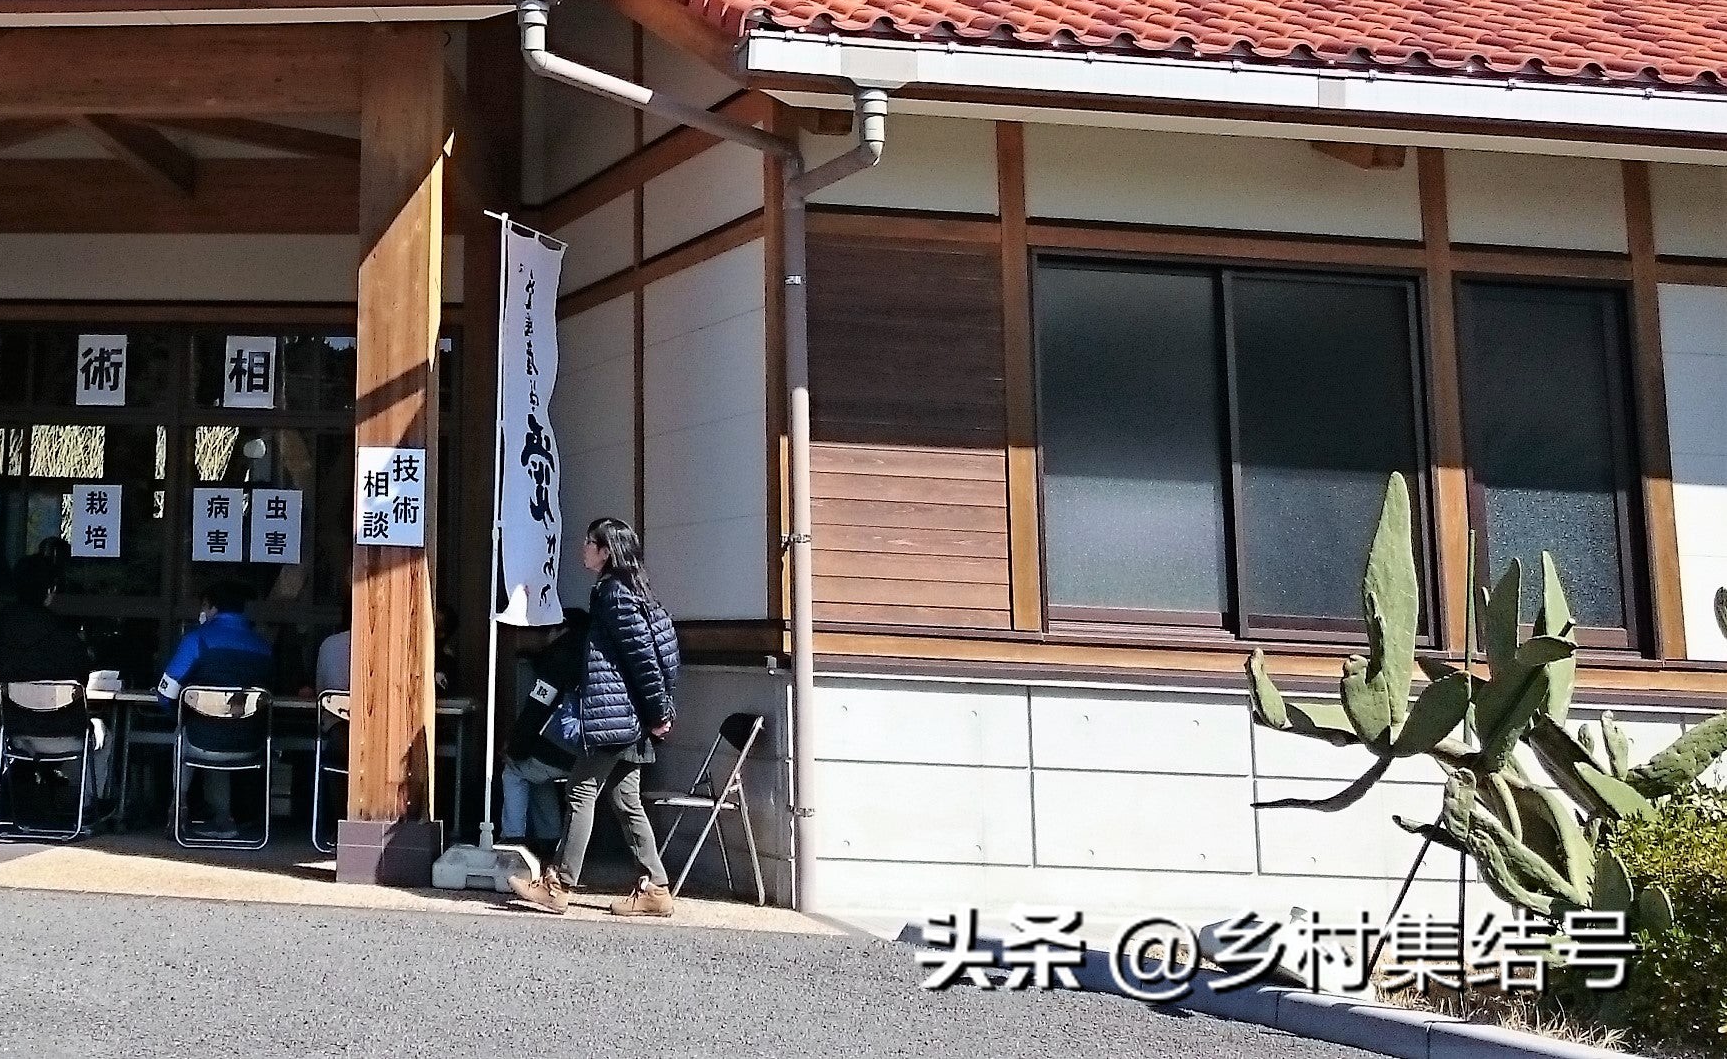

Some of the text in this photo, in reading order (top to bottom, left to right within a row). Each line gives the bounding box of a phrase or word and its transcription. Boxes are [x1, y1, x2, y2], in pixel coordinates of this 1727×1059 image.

[79, 347, 123, 391] 術
[228, 349, 271, 393] 相
[362, 470, 390, 539] 相談
[392, 454, 420, 524] 技術
[84, 491, 109, 550] 栽培
[206, 495, 230, 554] 病害
[264, 496, 288, 555] 虫害
